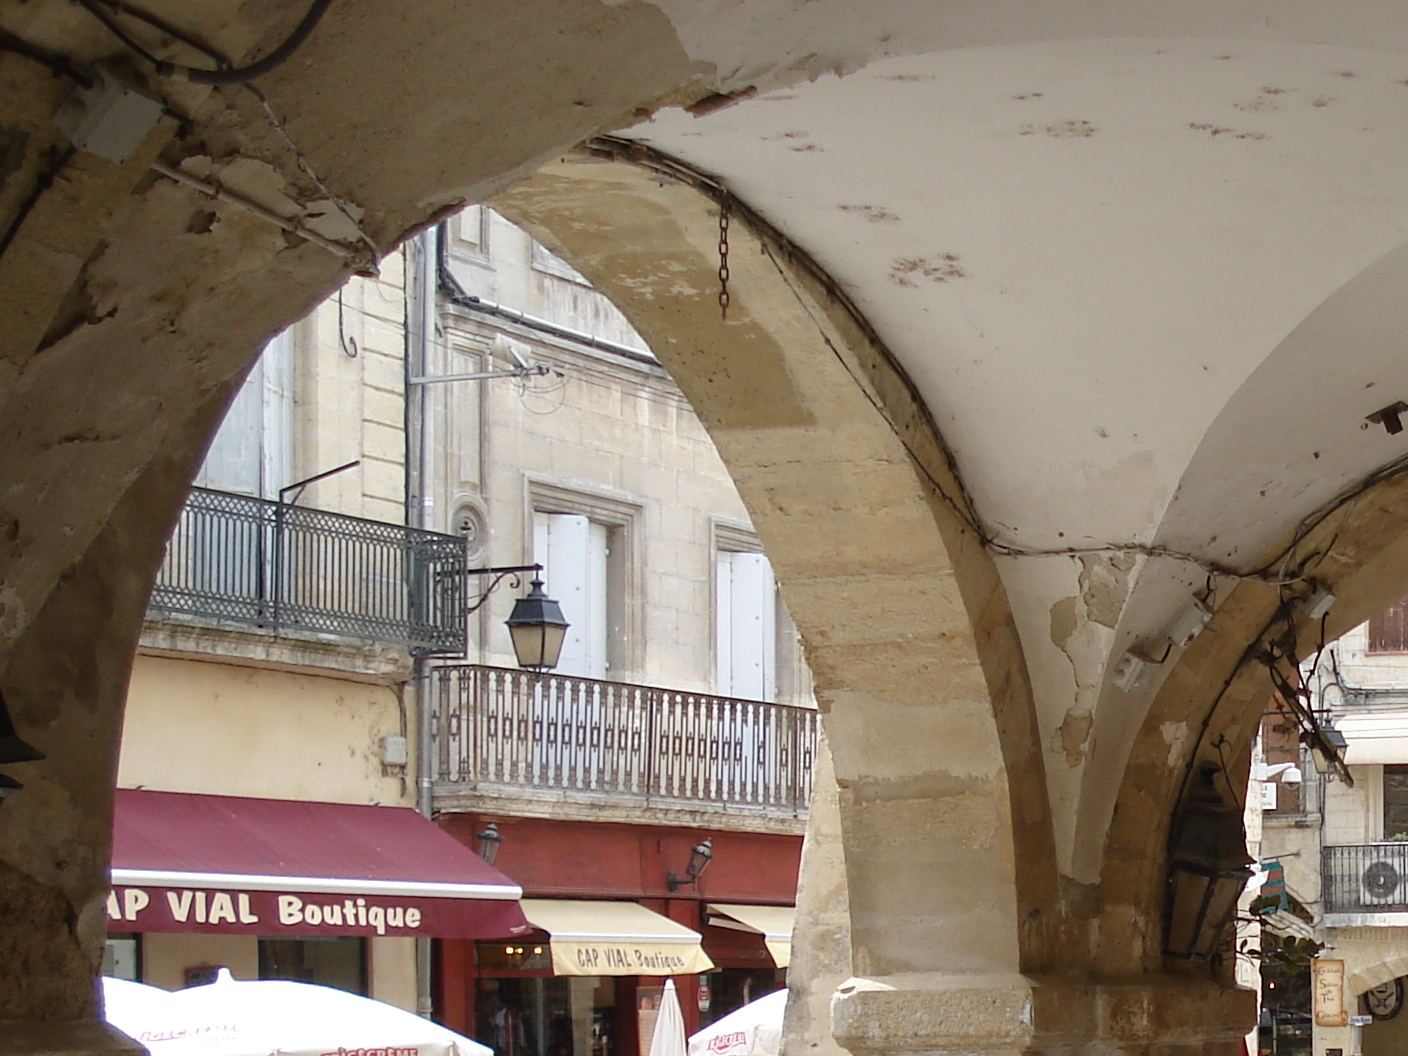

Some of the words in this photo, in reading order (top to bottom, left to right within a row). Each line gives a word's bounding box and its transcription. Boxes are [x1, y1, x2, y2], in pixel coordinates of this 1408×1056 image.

[166, 889, 259, 925] VIAL
[277, 894, 422, 936] Boutique
[576, 947, 599, 968] CAP
[605, 947, 632, 968] VIAL
[636, 948, 685, 972] Boutique
